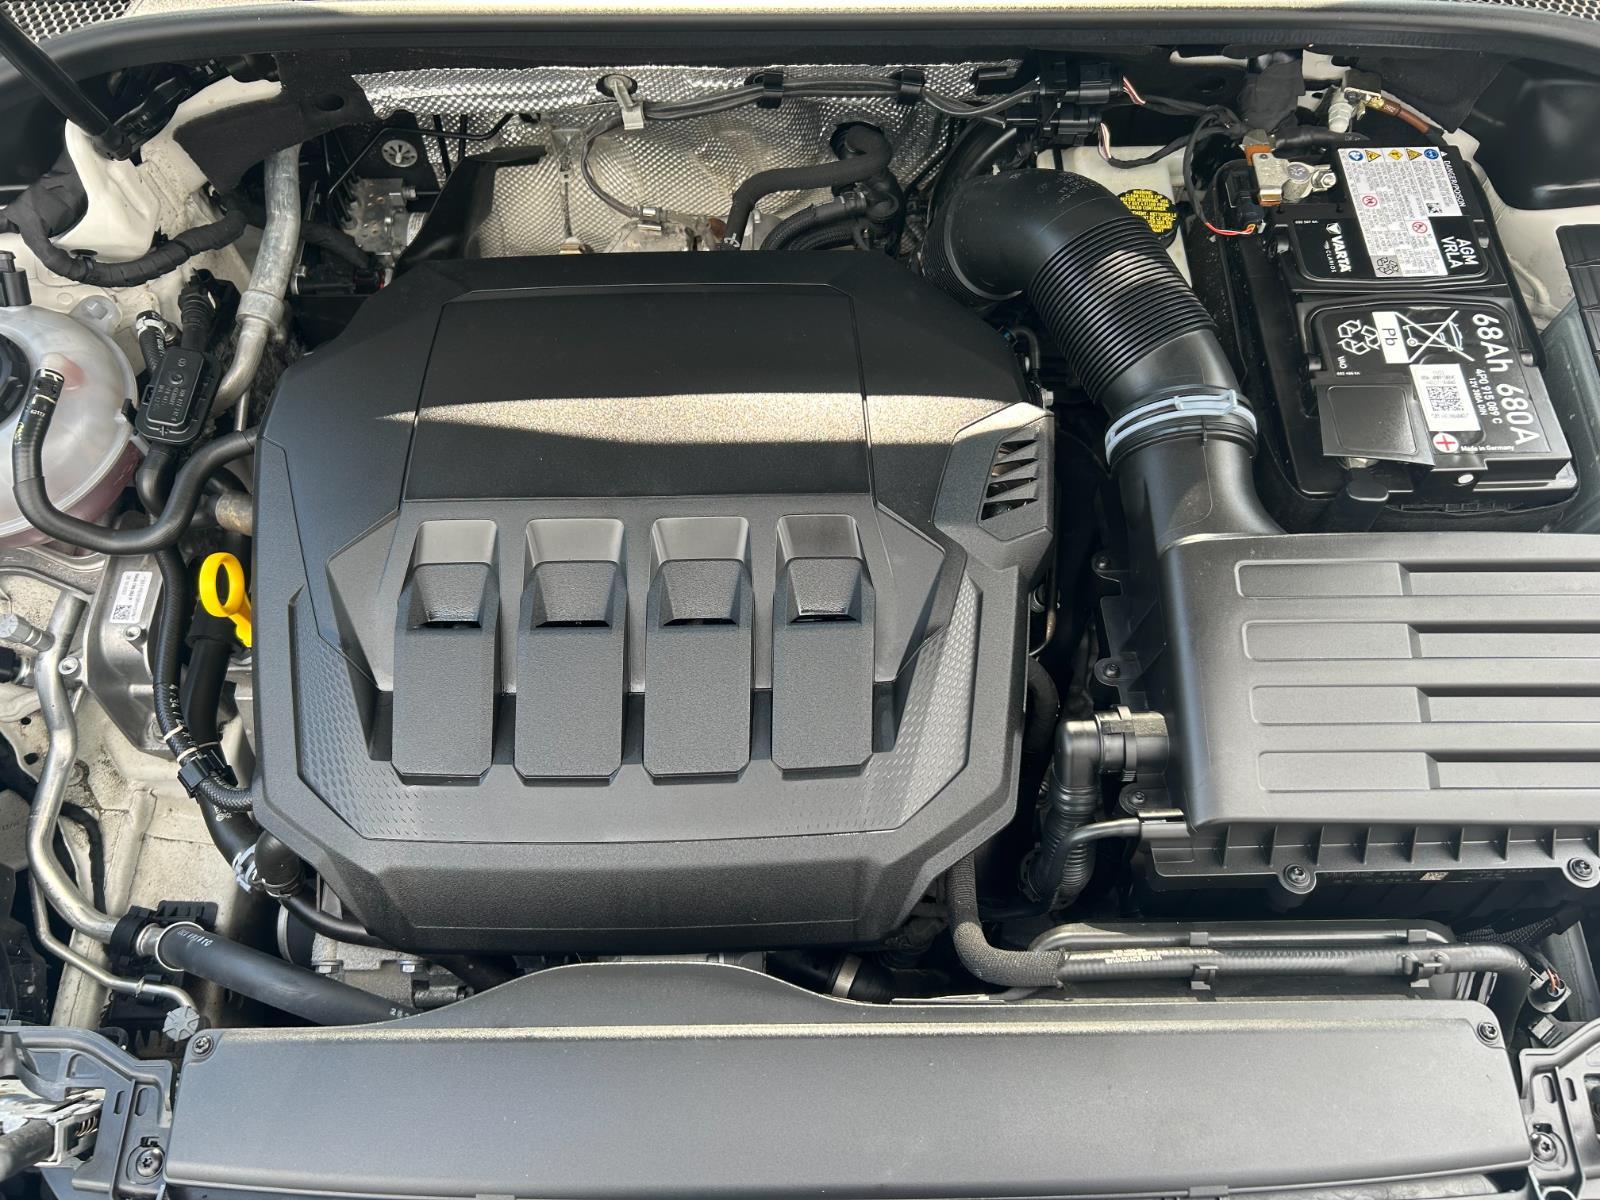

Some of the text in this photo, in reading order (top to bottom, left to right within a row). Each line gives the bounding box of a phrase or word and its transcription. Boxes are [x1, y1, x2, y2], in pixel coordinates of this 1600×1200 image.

[1443, 160, 1467, 208] DANGER/POISON
[1331, 235, 1352, 273] VARTA
[1441, 235, 1464, 269] VRLA
[1457, 238, 1480, 266] AGM
[1381, 327, 1399, 347] Pb
[1472, 313, 1541, 446] 68Ah 680A
[1477, 404, 1489, 416] DIN
[1481, 385, 1495, 401] 915
[1491, 417, 1503, 425] C
[1486, 444, 1515, 452] Germany
